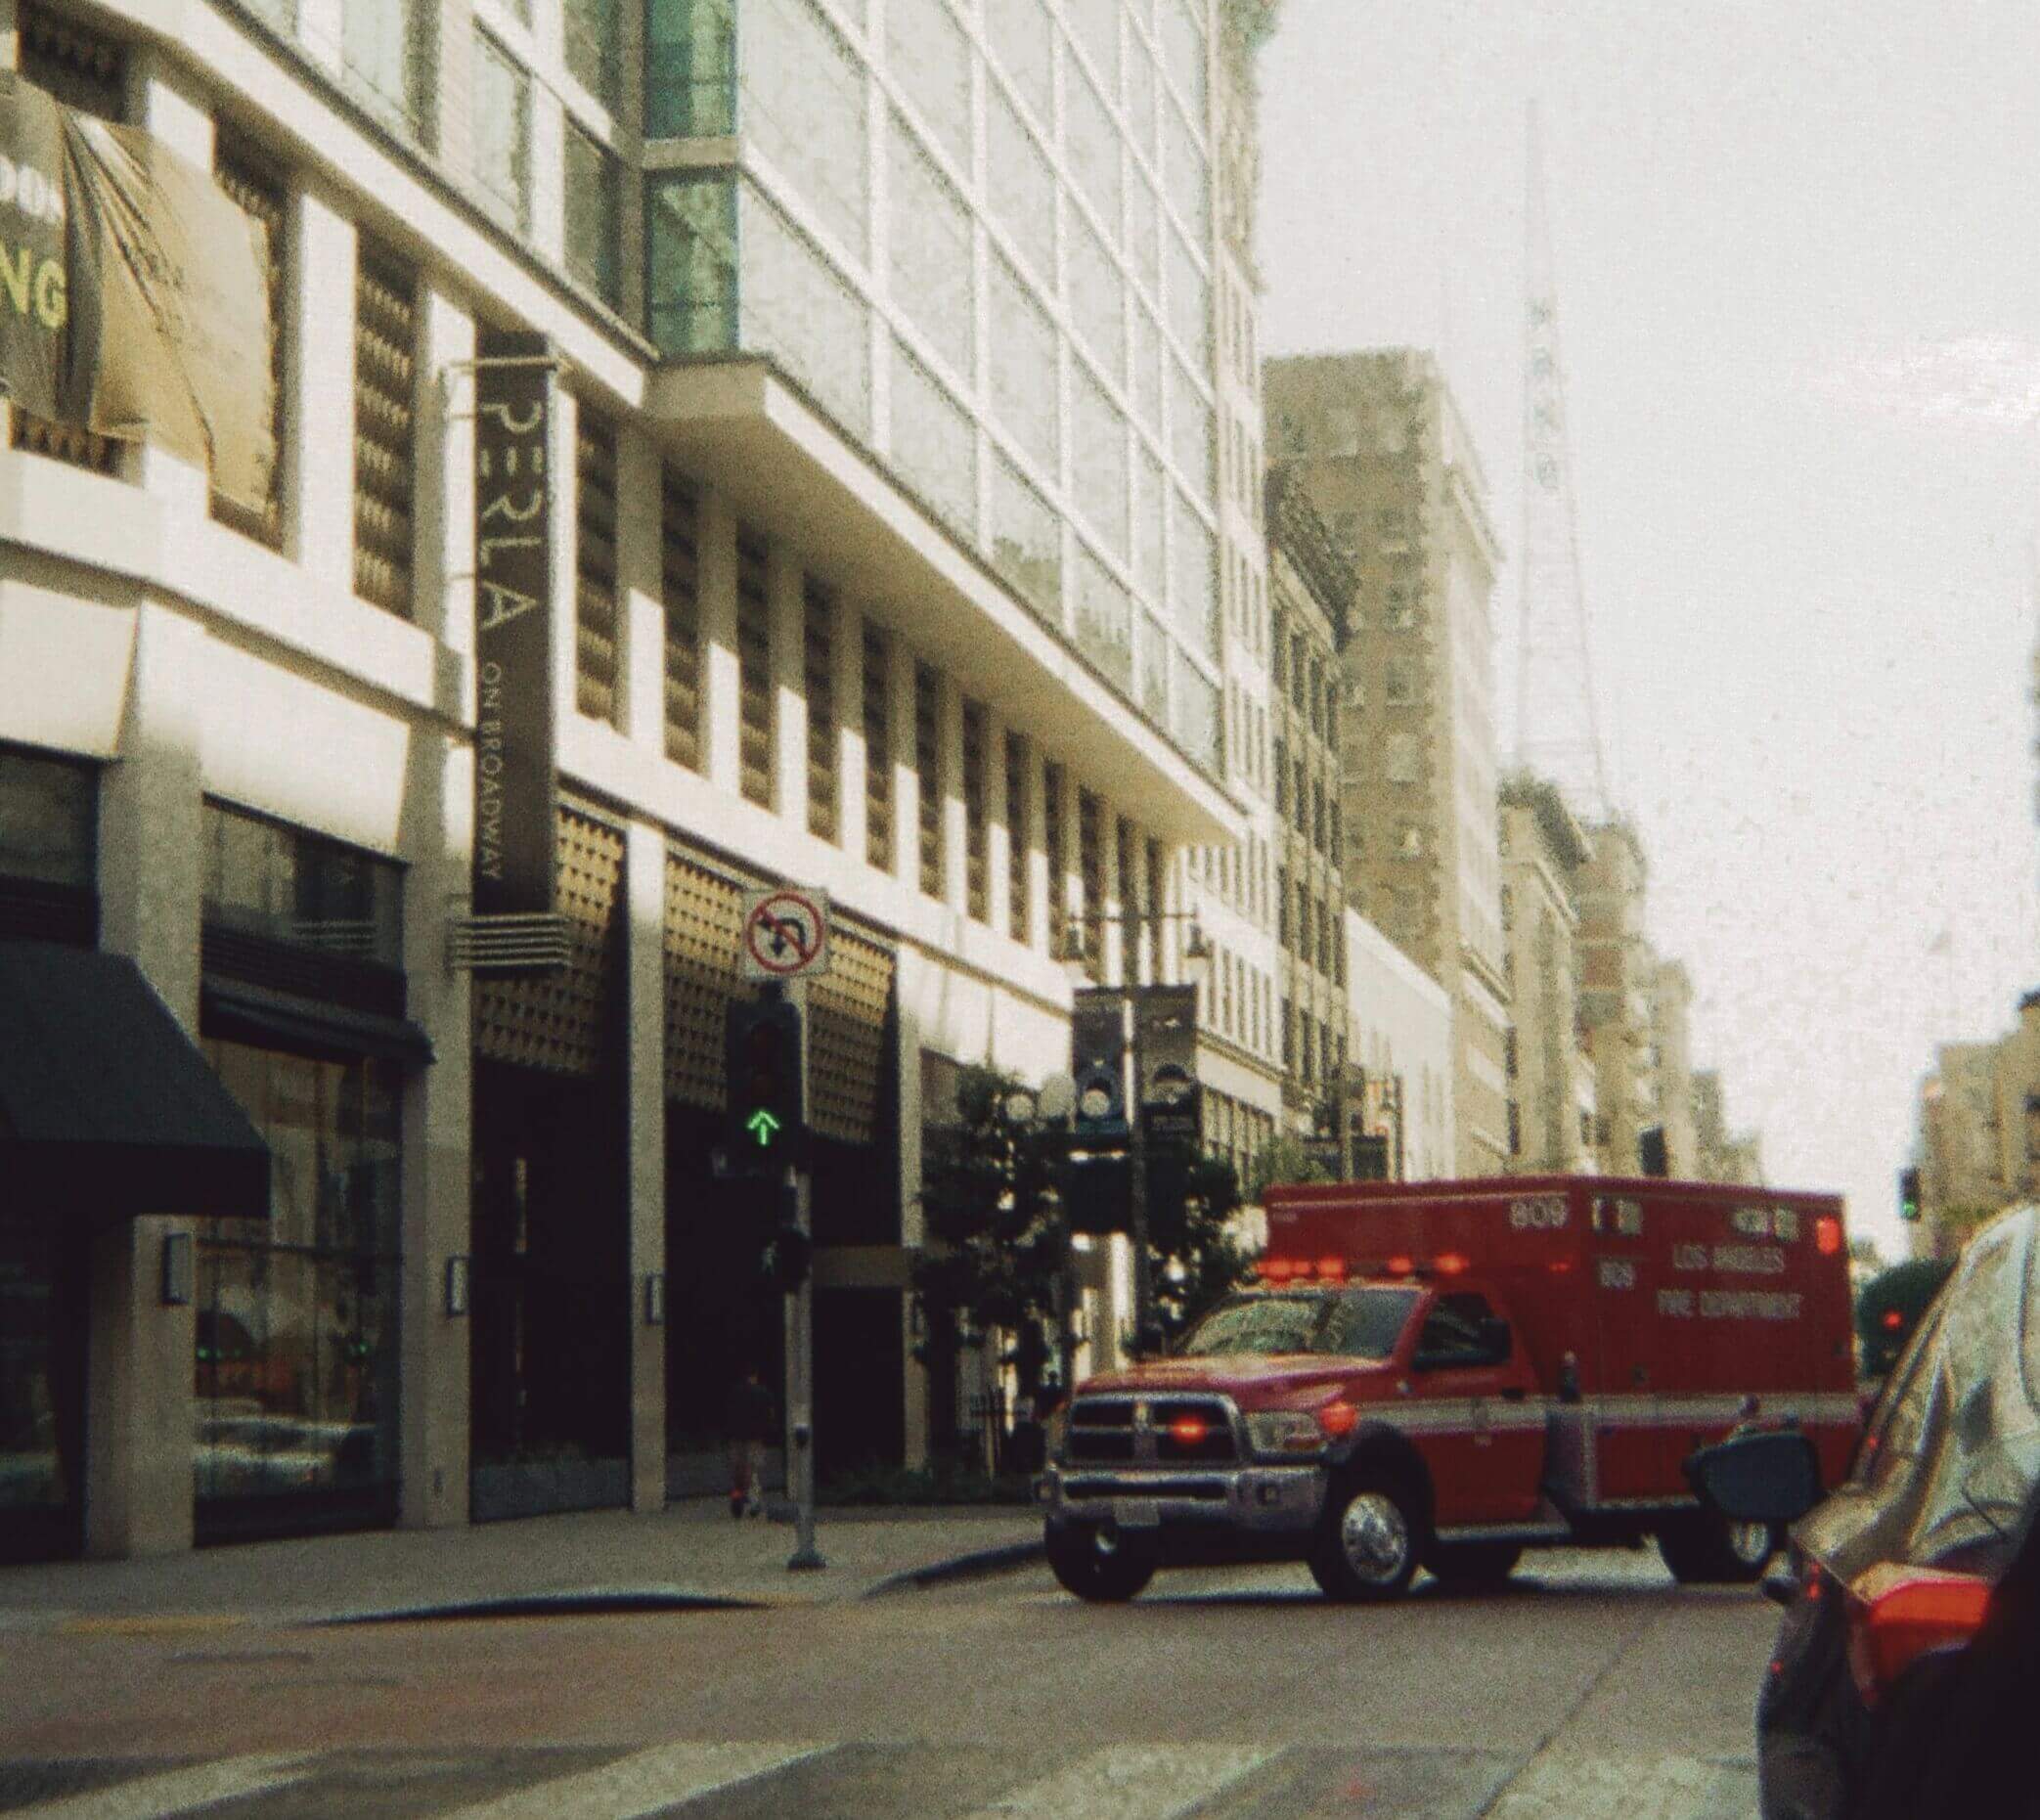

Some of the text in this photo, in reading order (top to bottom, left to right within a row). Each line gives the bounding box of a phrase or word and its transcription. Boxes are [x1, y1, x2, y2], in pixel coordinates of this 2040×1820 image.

[479, 401, 543, 630] PERLA
[480, 661, 504, 880] ON BROADWAY
